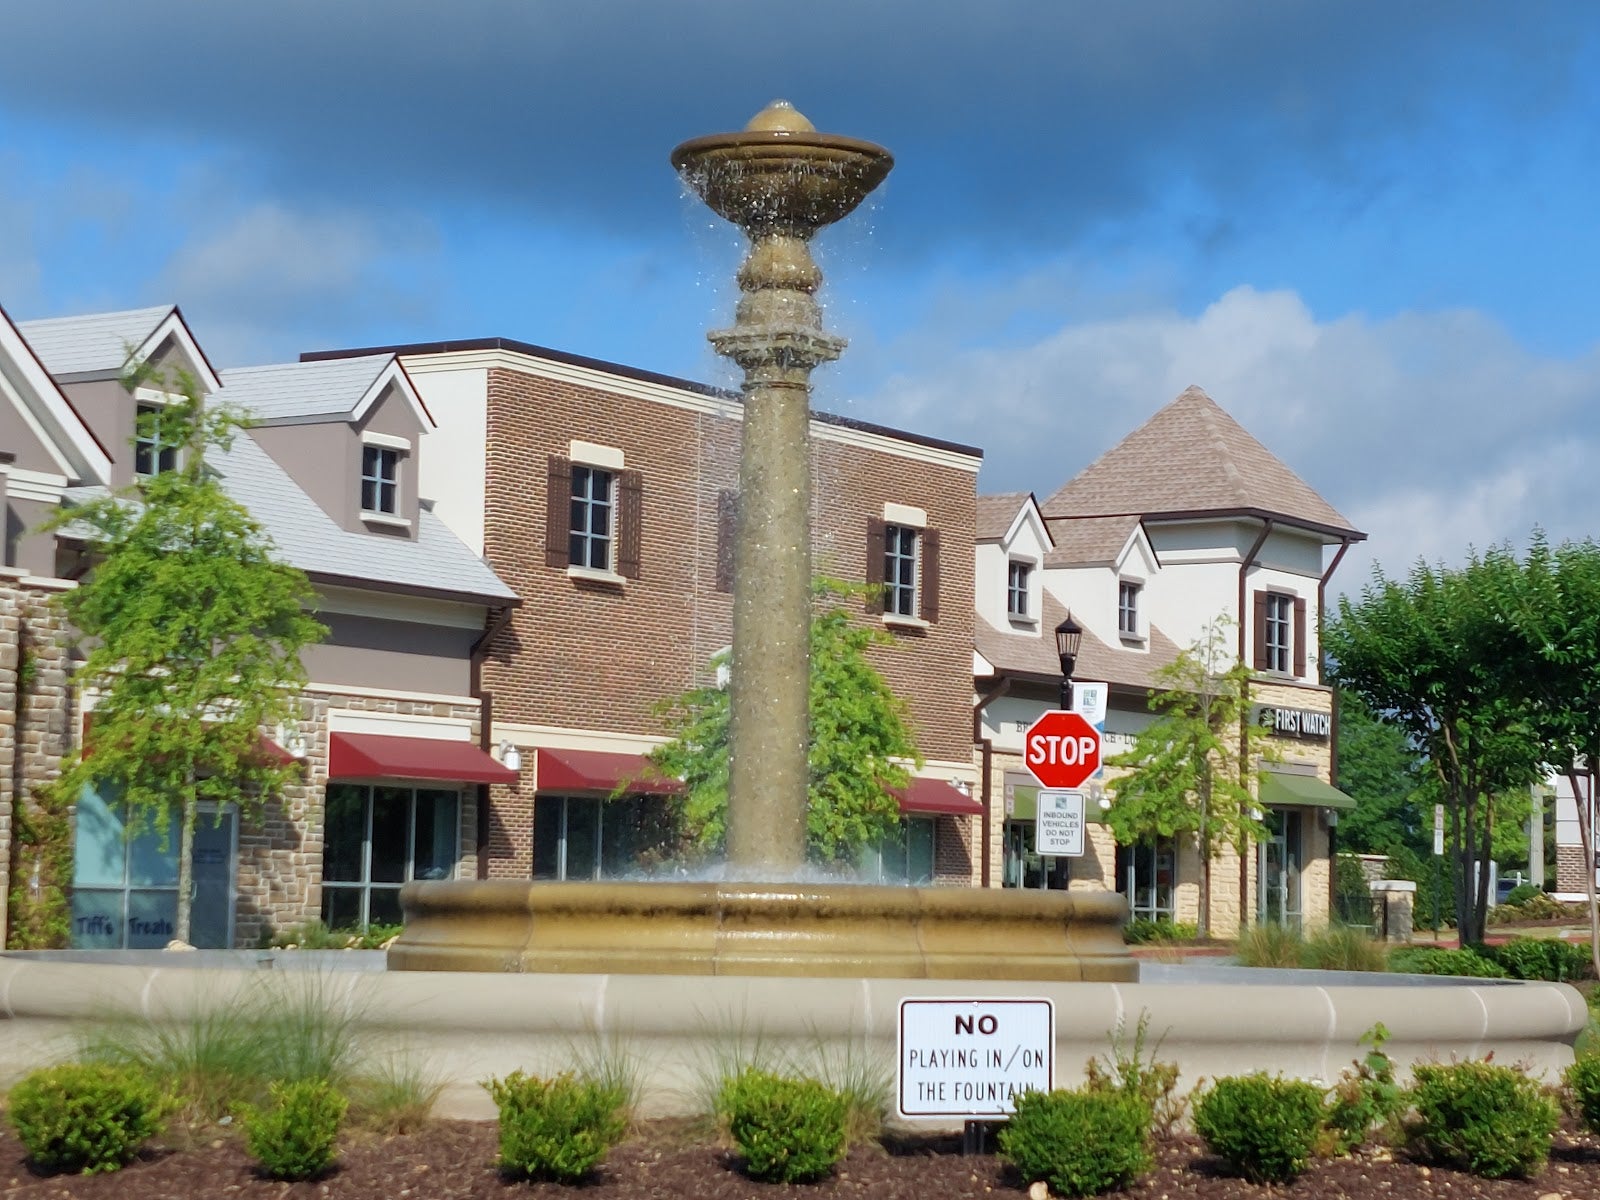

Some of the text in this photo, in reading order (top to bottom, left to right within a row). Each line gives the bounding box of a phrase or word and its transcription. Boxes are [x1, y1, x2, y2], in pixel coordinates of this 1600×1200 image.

[1275, 708, 1331, 735] FIRST WATCH
[1029, 735, 1096, 766] STOP
[1042, 820, 1079, 828] VEHICLES
[954, 1014, 999, 1035] NO
[909, 1044, 1043, 1072] PLAYING IN/ON
[918, 1082, 946, 1101] THE
